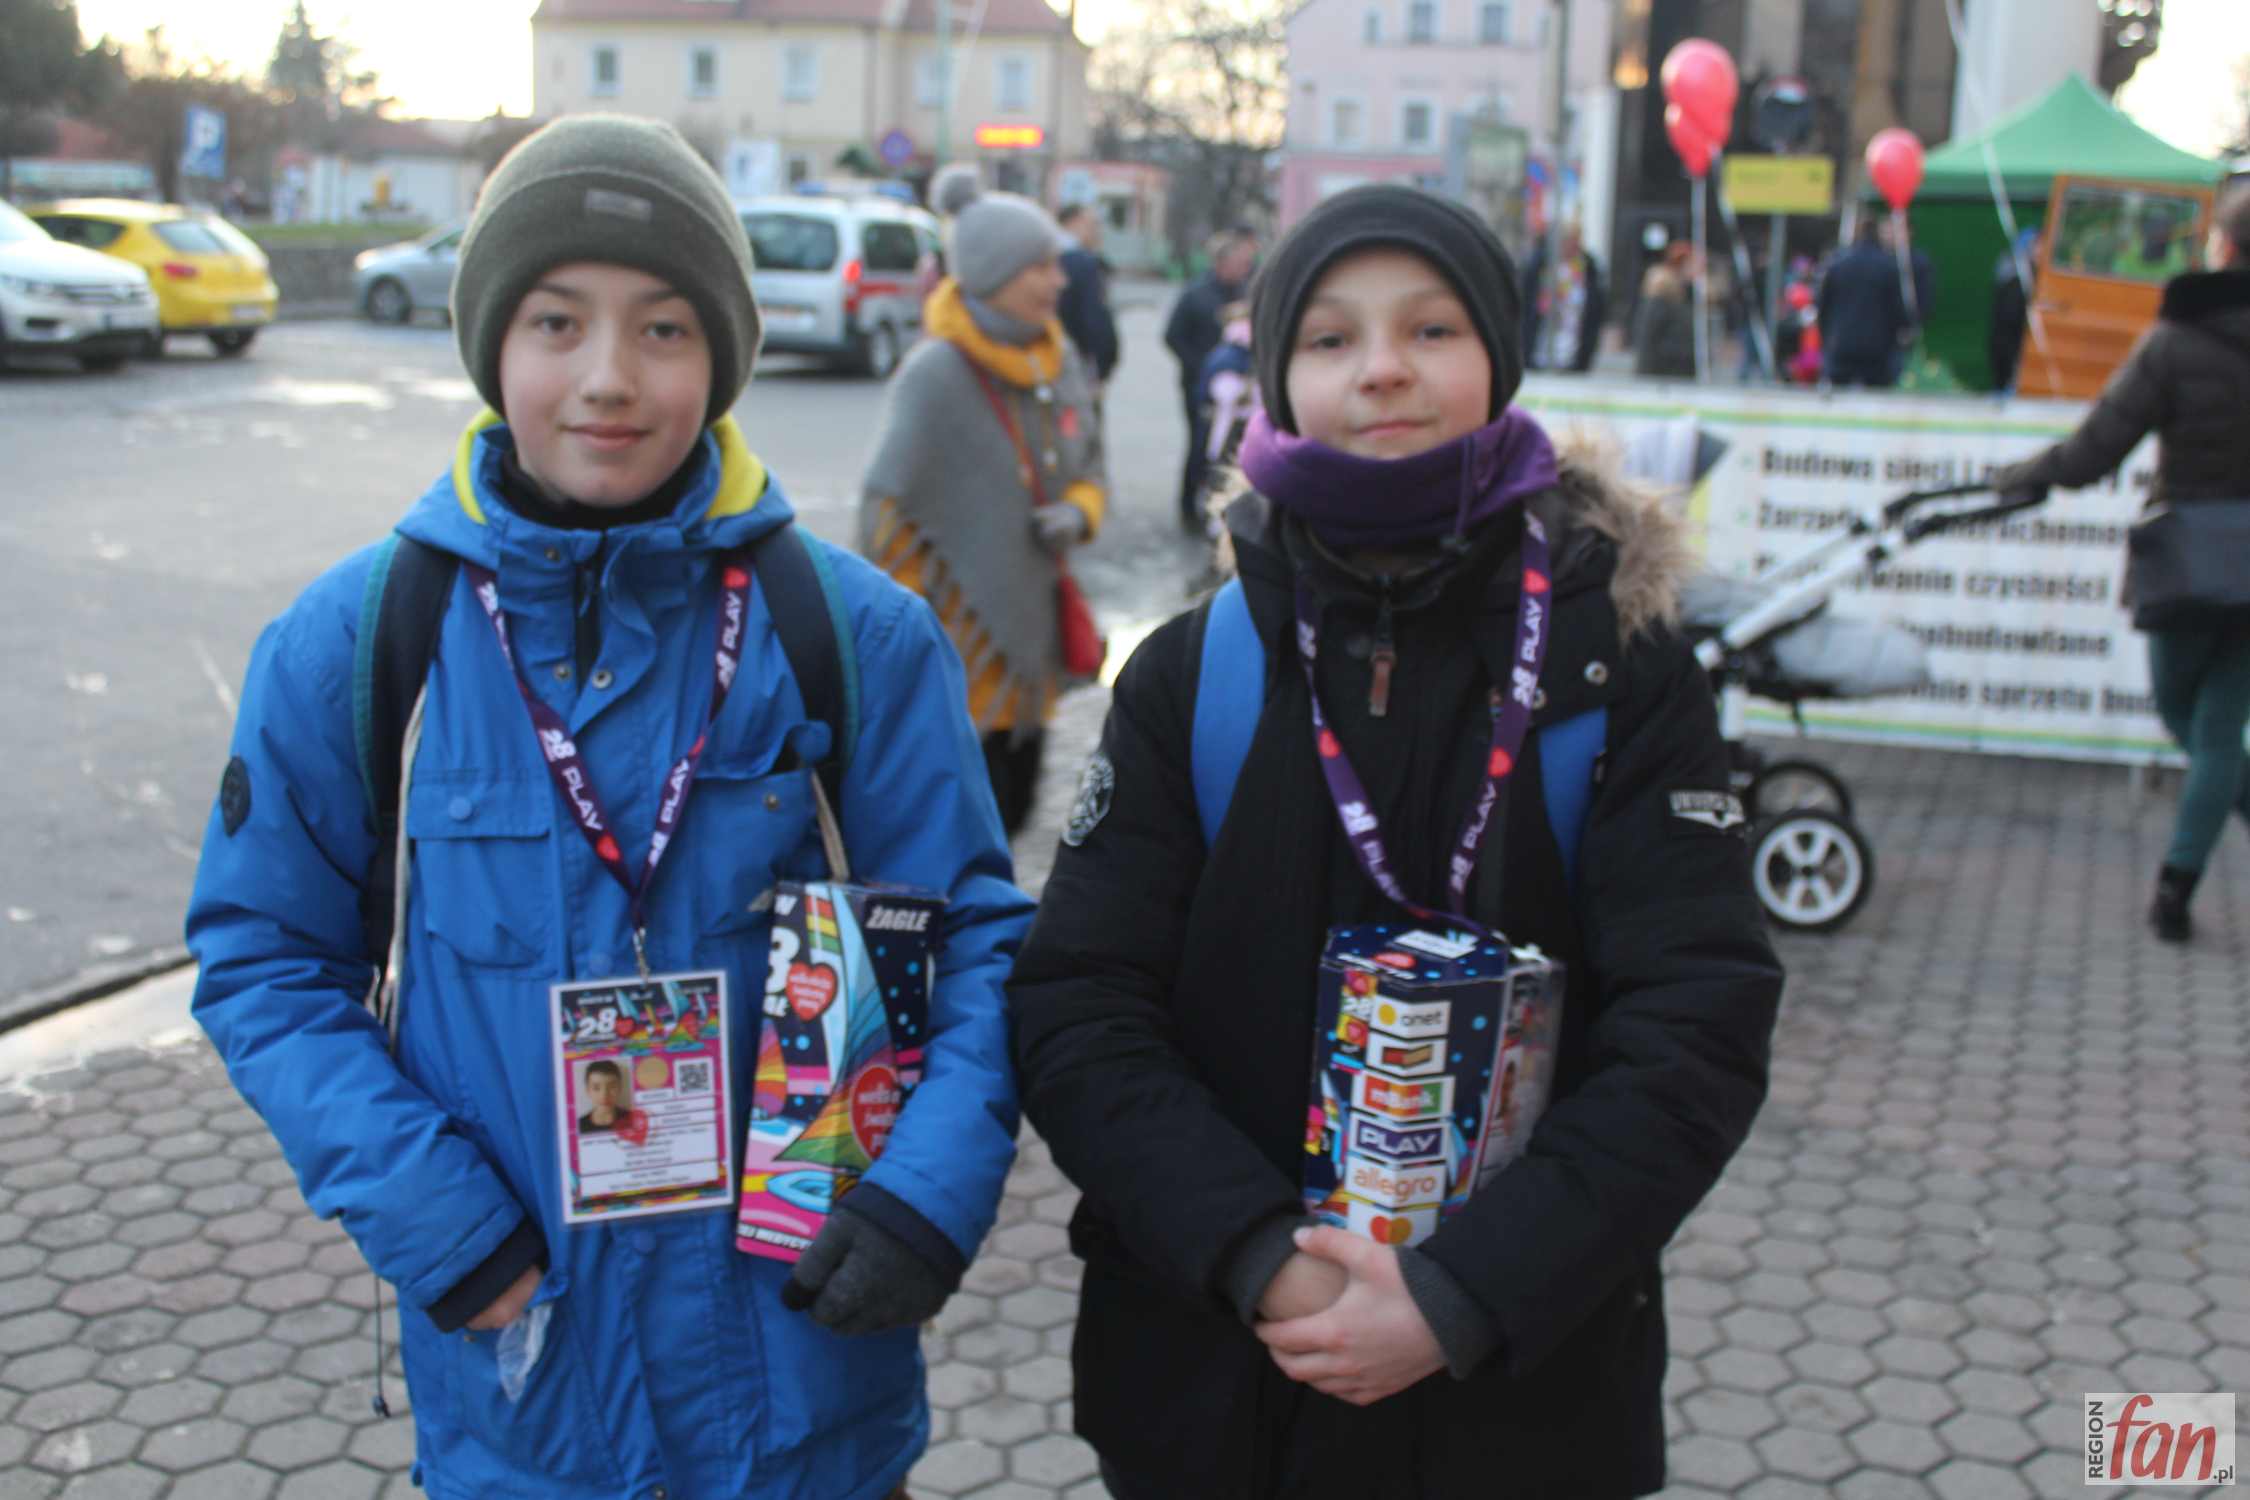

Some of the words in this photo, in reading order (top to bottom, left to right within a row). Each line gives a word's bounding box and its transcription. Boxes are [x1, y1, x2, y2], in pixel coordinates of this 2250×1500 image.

[721, 591, 743, 650] PLAY
[1521, 597, 1543, 662] PLAY
[539, 728, 576, 763] 28
[562, 766, 603, 832] PLAY
[661, 758, 690, 825] PLAY
[1462, 782, 1497, 850] PLAY
[866, 905, 931, 932] ŻAGLE
[576, 1007, 618, 1038] 28
[1401, 1010, 1442, 1026] onet
[1360, 1125, 1438, 1154] PLAY
[1354, 1167, 1436, 1199] allegro
